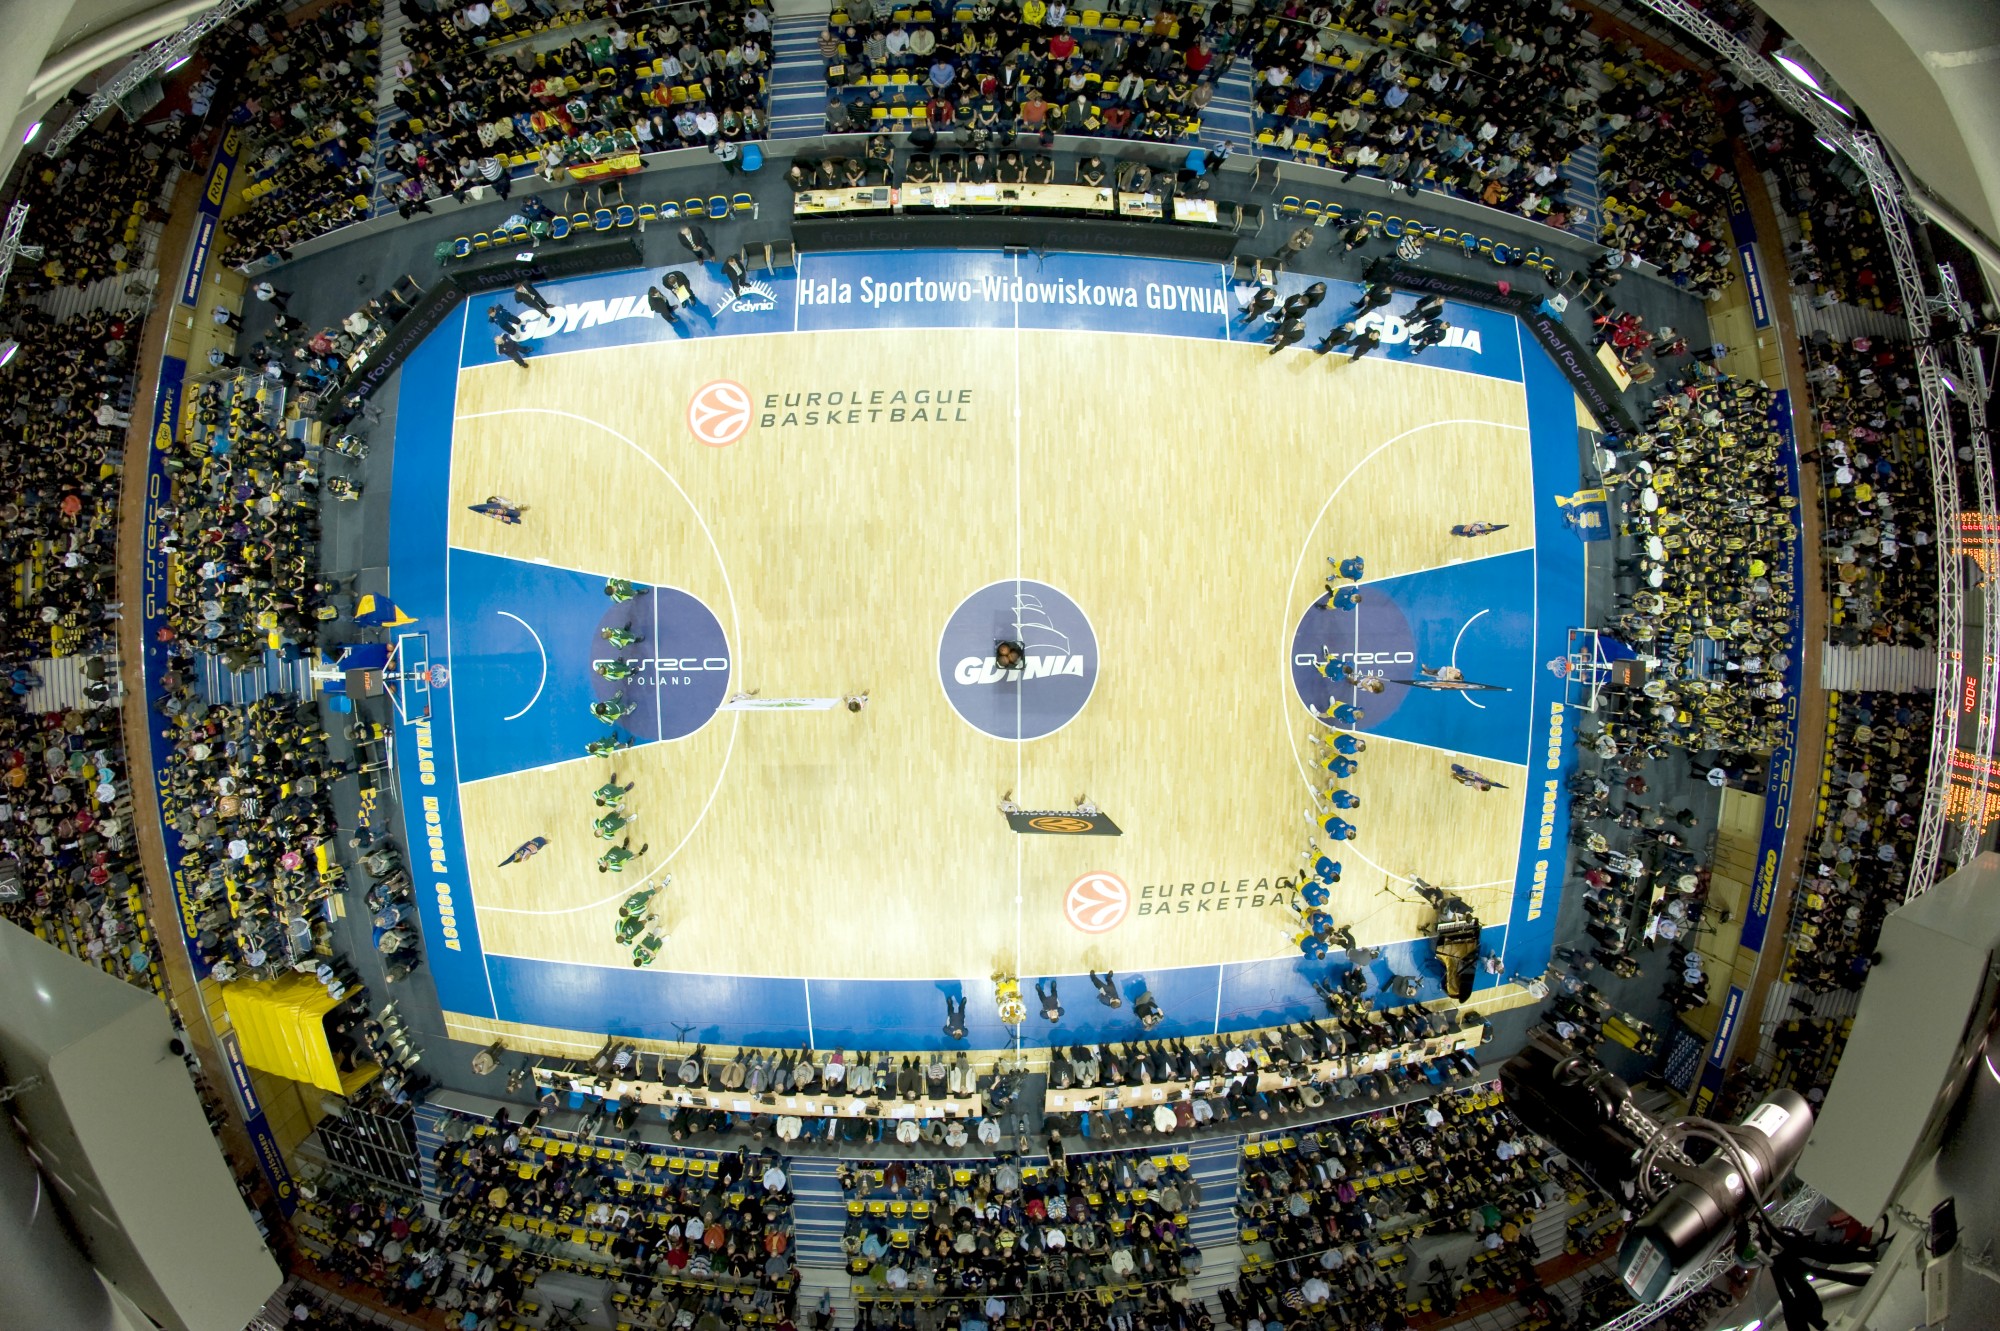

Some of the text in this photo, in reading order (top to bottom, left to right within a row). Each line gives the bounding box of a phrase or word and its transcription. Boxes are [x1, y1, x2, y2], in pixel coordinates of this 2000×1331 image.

[211, 168, 224, 199] RMF
[732, 299, 774, 313] Gdynia
[799, 274, 1228, 316] Hala Sportowo-Widowiskowa GDYNIA
[368, 290, 456, 382] four PARIS 2010
[1537, 320, 1567, 352] final
[1560, 350, 1587, 386] four
[1582, 379, 1609, 414] PARIS
[760, 407, 967, 428] BASKETBALL
[764, 389, 973, 409] EUROLEAGUE
[627, 676, 691, 686] POLAND
[157, 767, 177, 827] BMG
[1527, 701, 1564, 922] ASSECO PROKOM GDYNIA
[422, 795, 448, 874] PROKOM
[1138, 892, 1300, 916] BASKETBAL
[1757, 849, 1777, 916] GDYNIA
[436, 881, 461, 953] ASSECO
